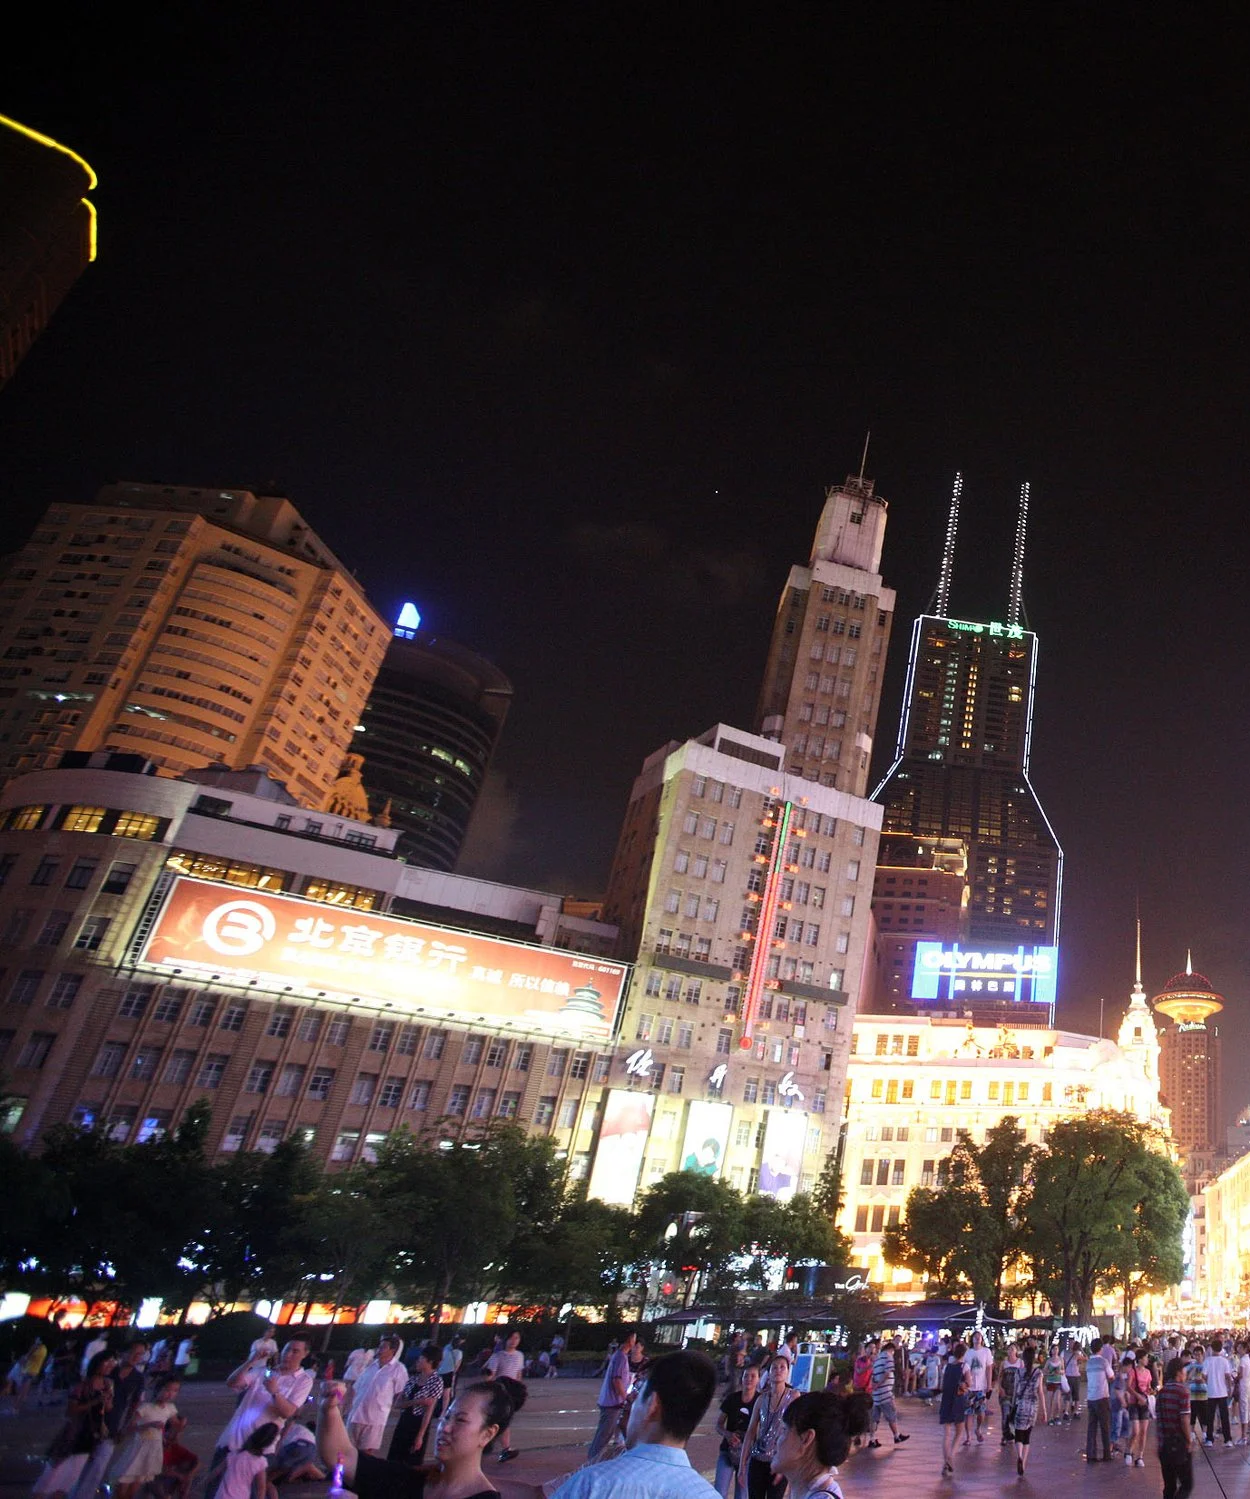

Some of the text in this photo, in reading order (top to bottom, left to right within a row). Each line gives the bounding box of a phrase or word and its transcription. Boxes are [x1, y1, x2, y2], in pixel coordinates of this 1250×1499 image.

[287, 917, 468, 973] 北京银行
[921, 950, 1052, 972] OLYMPUS
